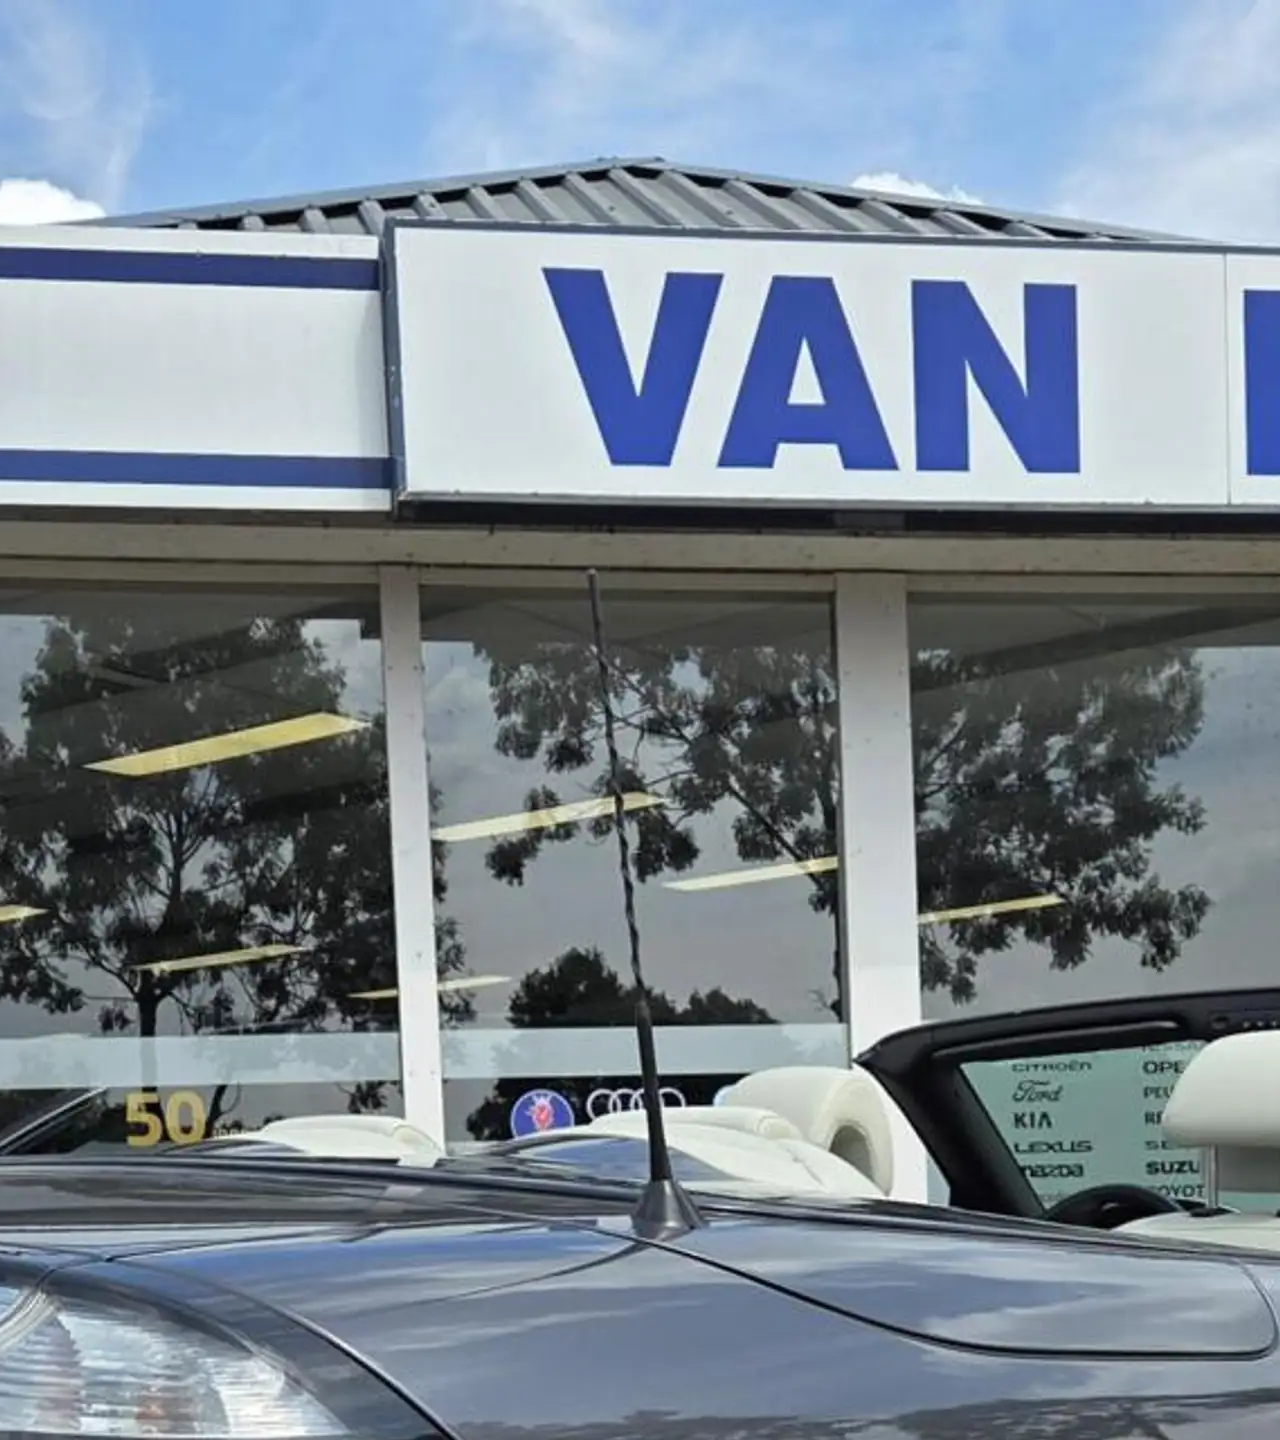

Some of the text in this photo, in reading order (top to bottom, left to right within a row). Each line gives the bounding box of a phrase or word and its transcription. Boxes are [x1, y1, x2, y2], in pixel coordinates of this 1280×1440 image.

[541, 268, 1079, 473] VAN
[1012, 1080, 1063, 1103] Ford
[126, 1090, 205, 1145] 50
[1014, 1111, 1052, 1129] KIA
[1014, 1140, 1092, 1153] LEXUS
